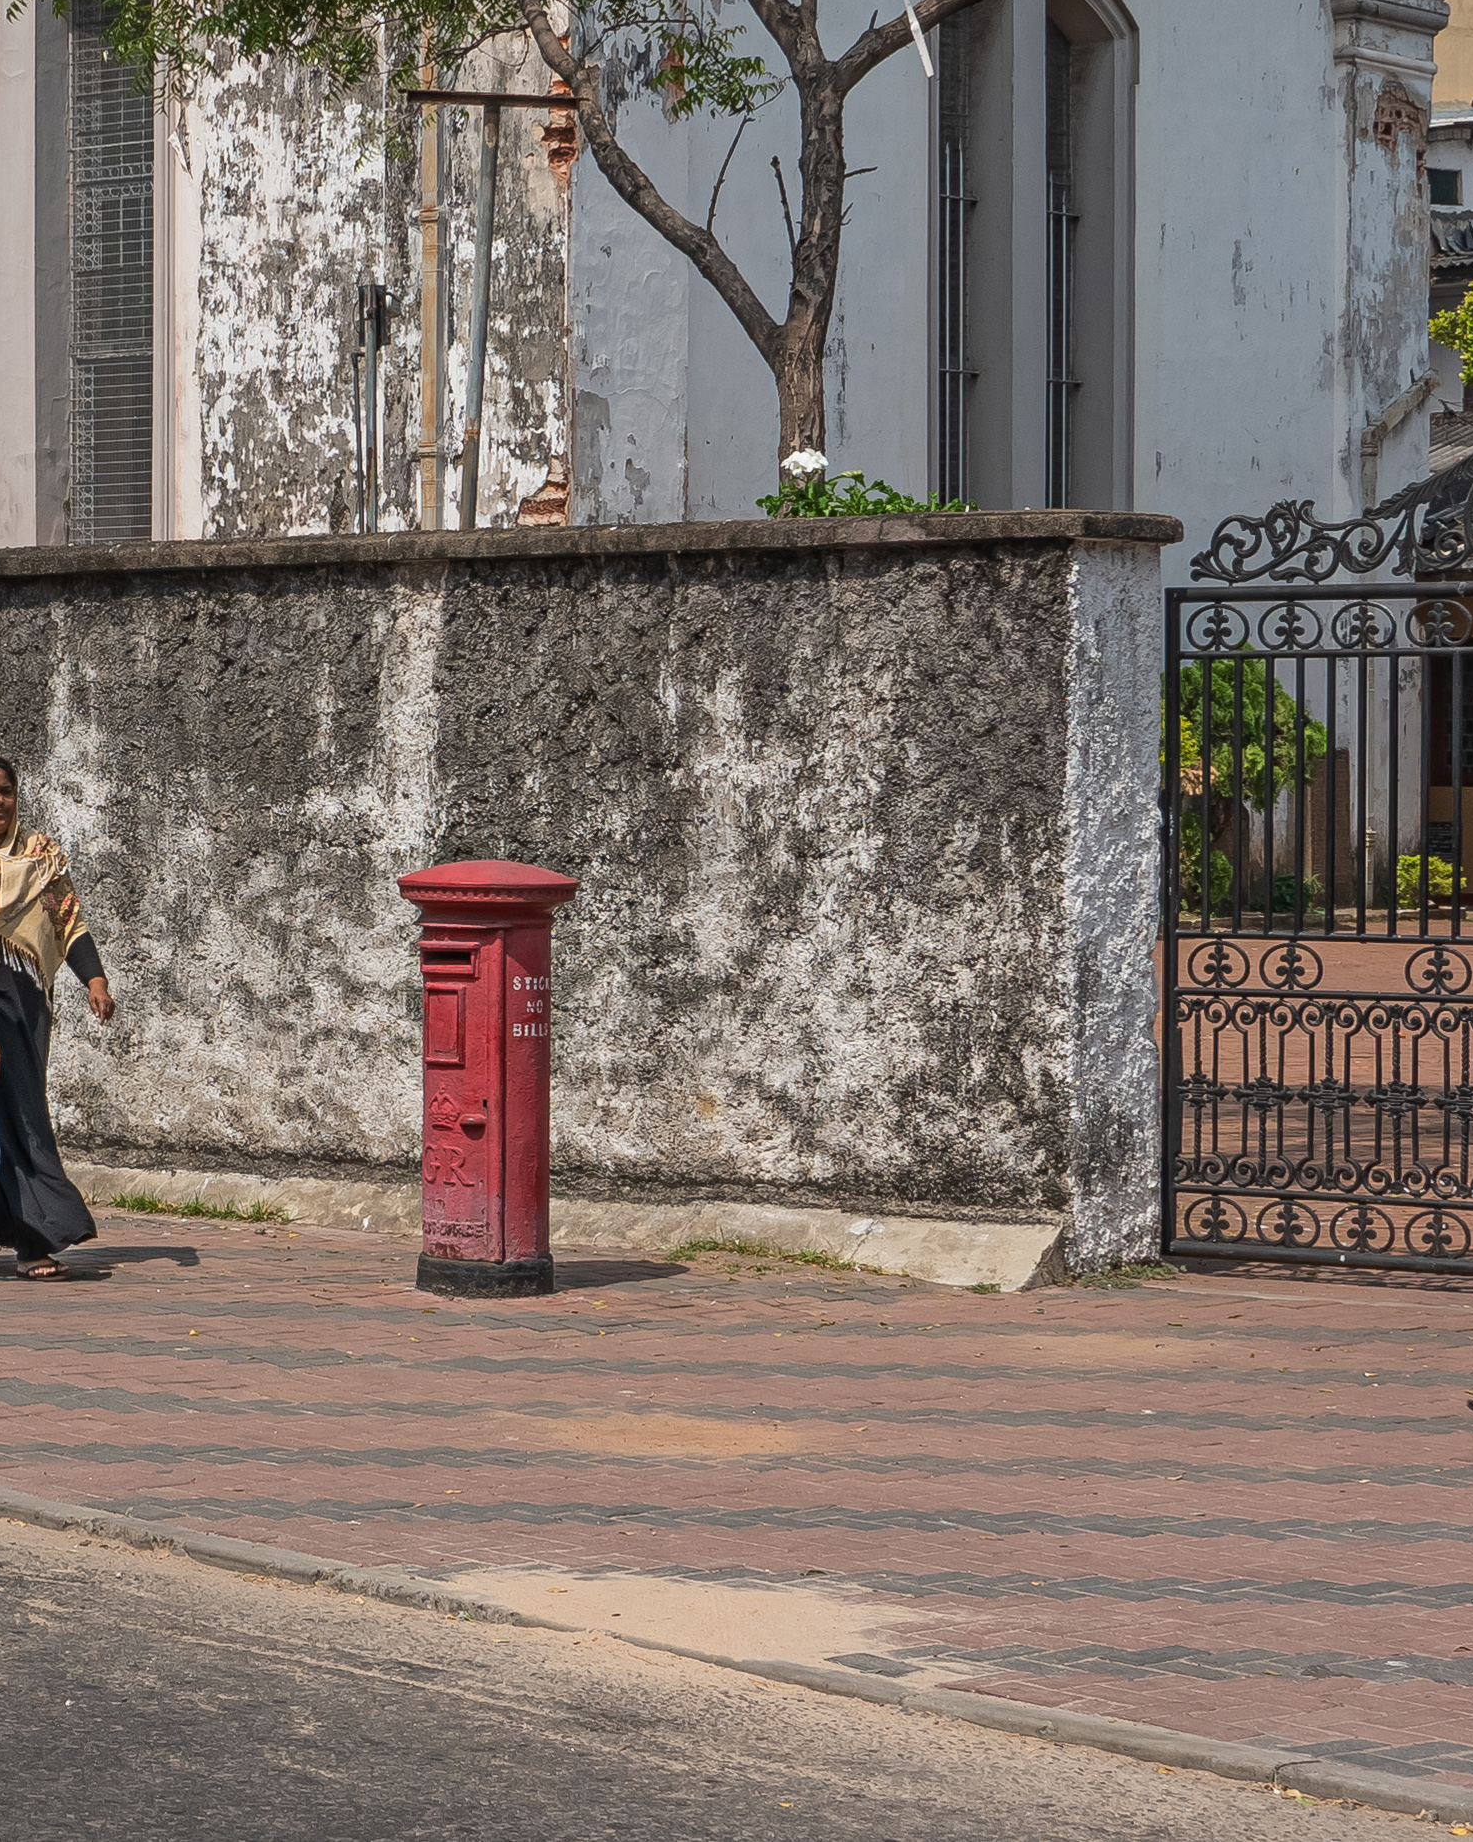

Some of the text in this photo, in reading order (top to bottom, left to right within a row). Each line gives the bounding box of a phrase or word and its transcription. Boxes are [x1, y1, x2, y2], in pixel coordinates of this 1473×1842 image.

[513, 976, 550, 990] STICK
[526, 1000, 543, 1013] NO
[424, 1143, 475, 1188] GR
